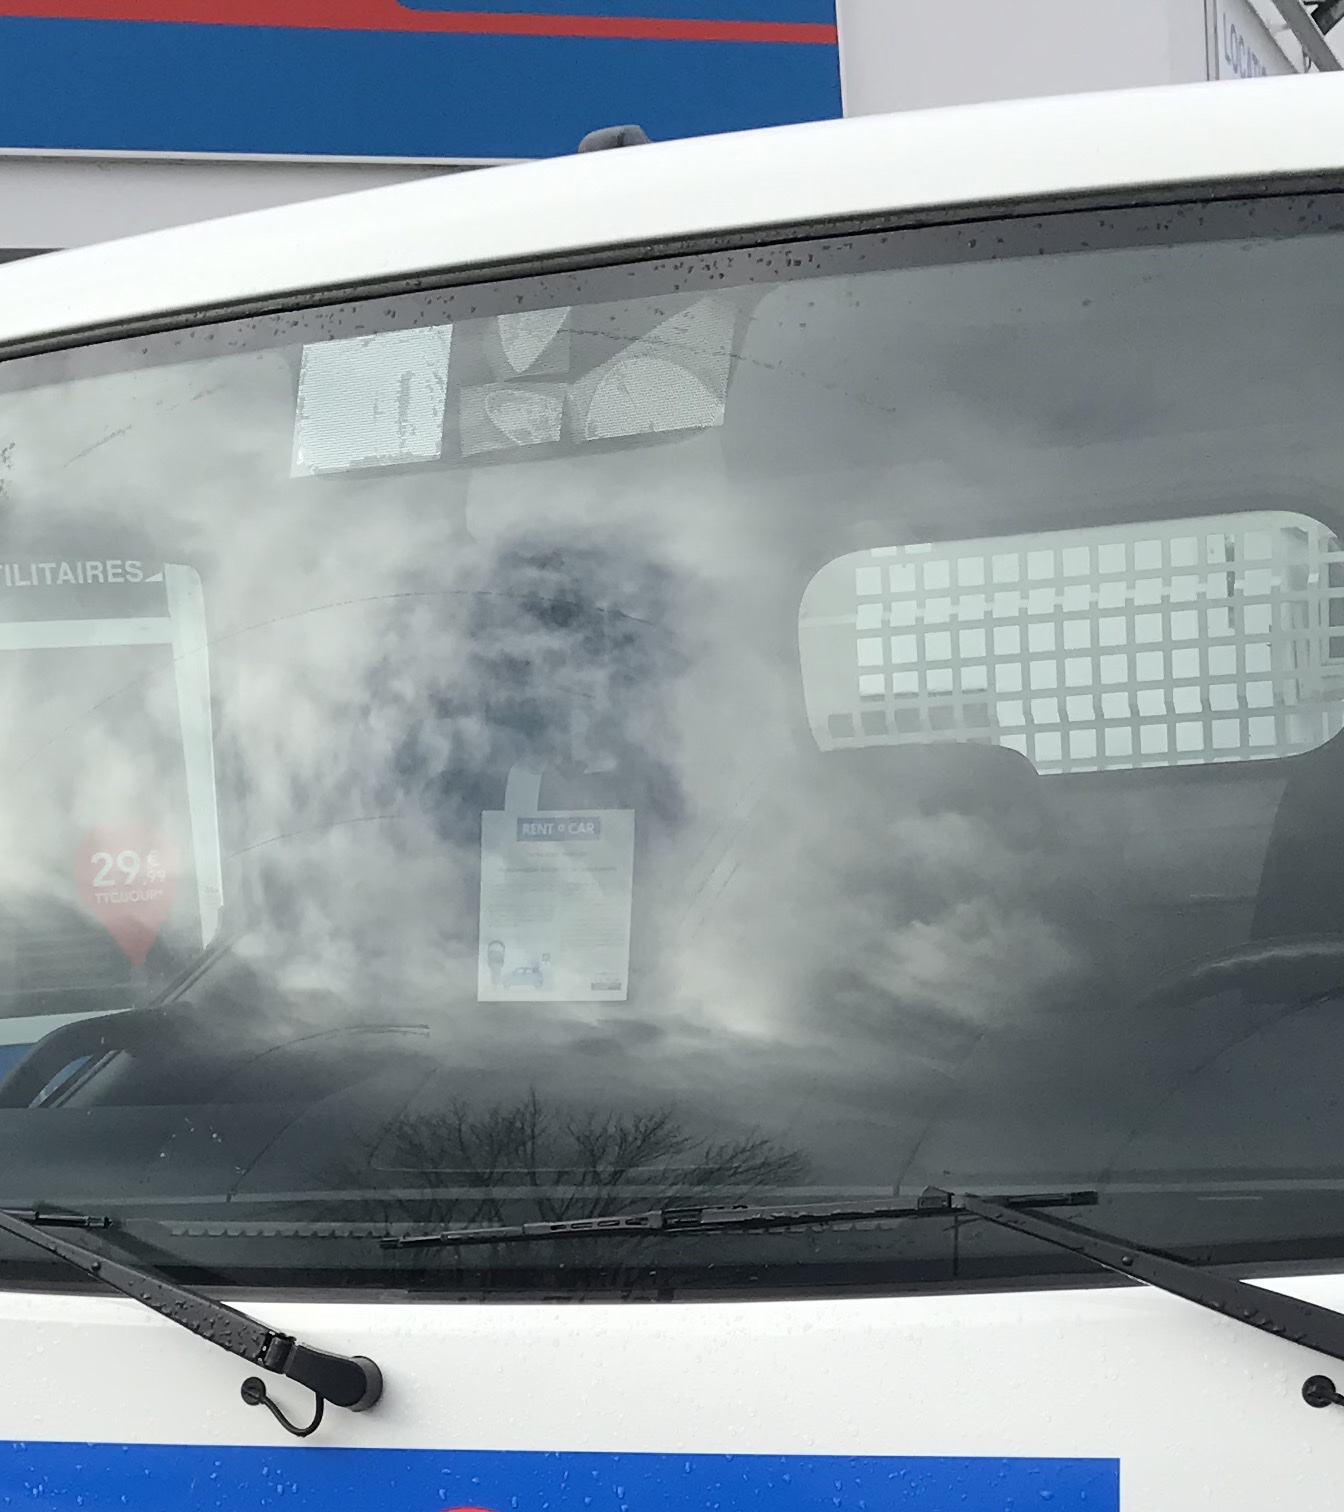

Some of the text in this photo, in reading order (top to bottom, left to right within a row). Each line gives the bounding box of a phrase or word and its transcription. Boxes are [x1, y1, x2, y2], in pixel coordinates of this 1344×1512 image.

[1223, 12, 1267, 77] LOCAT
[522, 823, 554, 835] RENT
[568, 822, 595, 835] CAR
